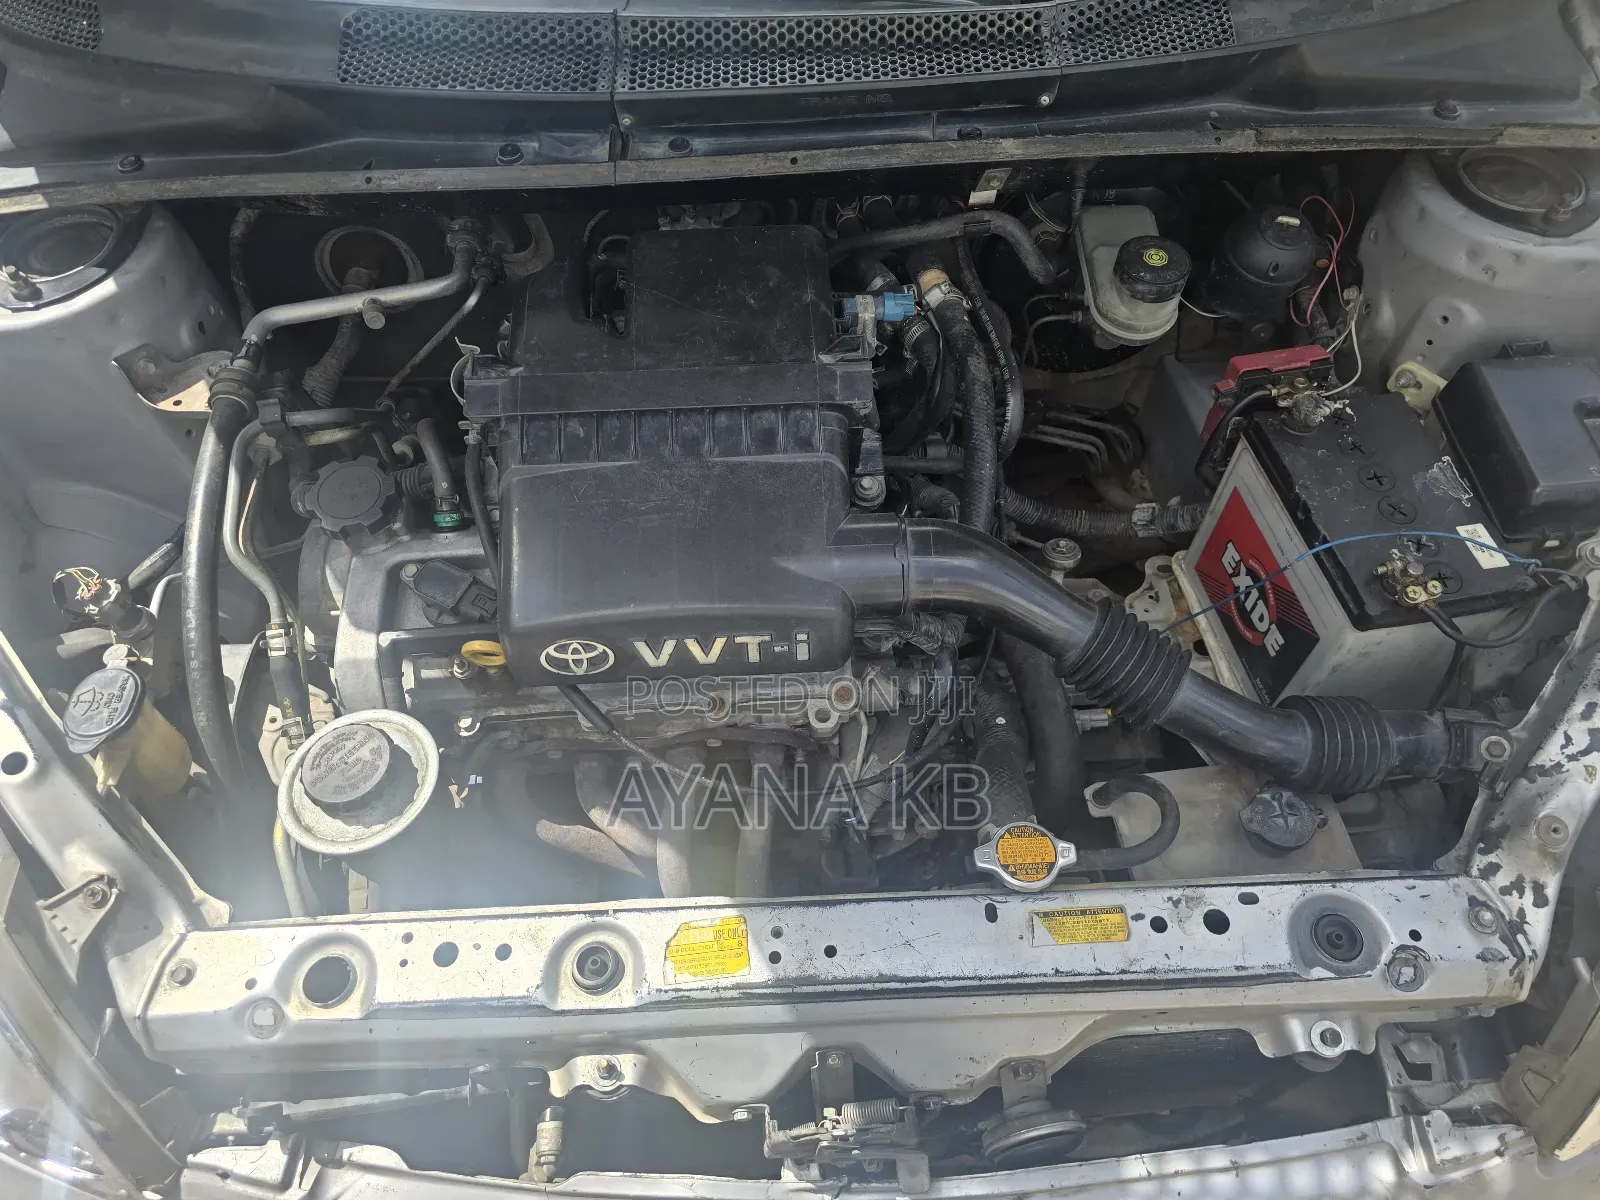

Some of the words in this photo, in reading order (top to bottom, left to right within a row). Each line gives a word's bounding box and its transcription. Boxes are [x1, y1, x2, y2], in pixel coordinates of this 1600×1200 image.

[1221, 541, 1285, 657] EXIDE
[632, 631, 811, 668] VVT-i
[310, 762, 340, 788] POWER
[338, 733, 375, 764] STEERING
[1086, 907, 1122, 916] ATTENTION
[713, 929, 726, 940] USE
